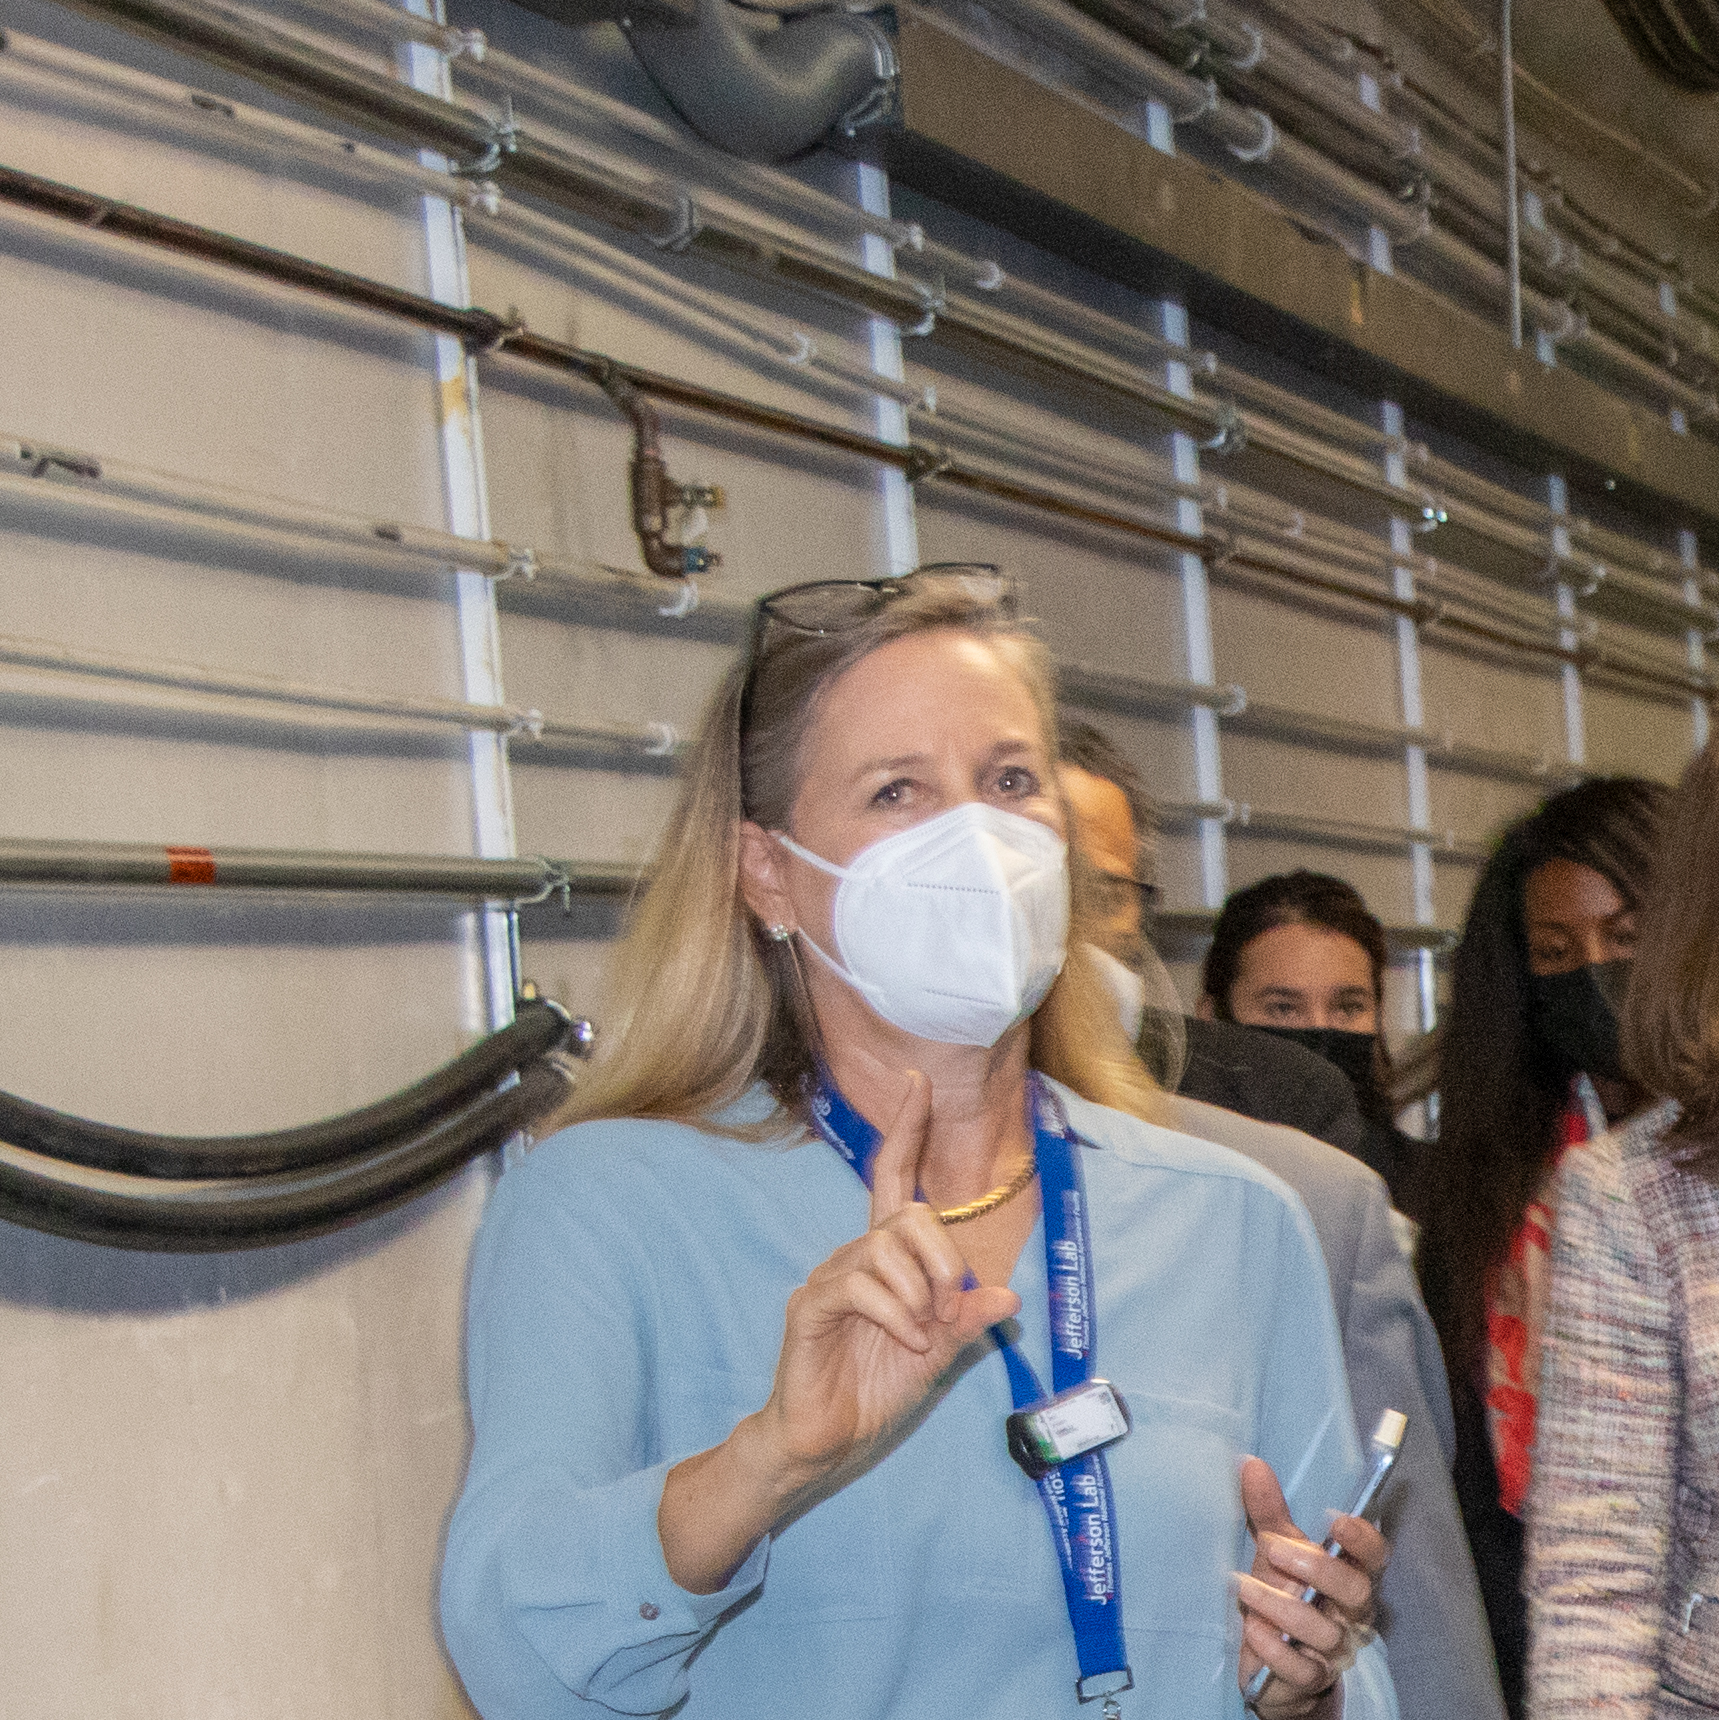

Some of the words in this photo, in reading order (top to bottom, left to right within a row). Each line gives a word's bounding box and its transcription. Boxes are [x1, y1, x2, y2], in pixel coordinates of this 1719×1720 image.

[1058, 1241, 1078, 1272] Lab
[1064, 1276, 1083, 1360] Jefferson
[1078, 1475, 1099, 1508] Lab
[1087, 1514, 1107, 1605] Jefferson
